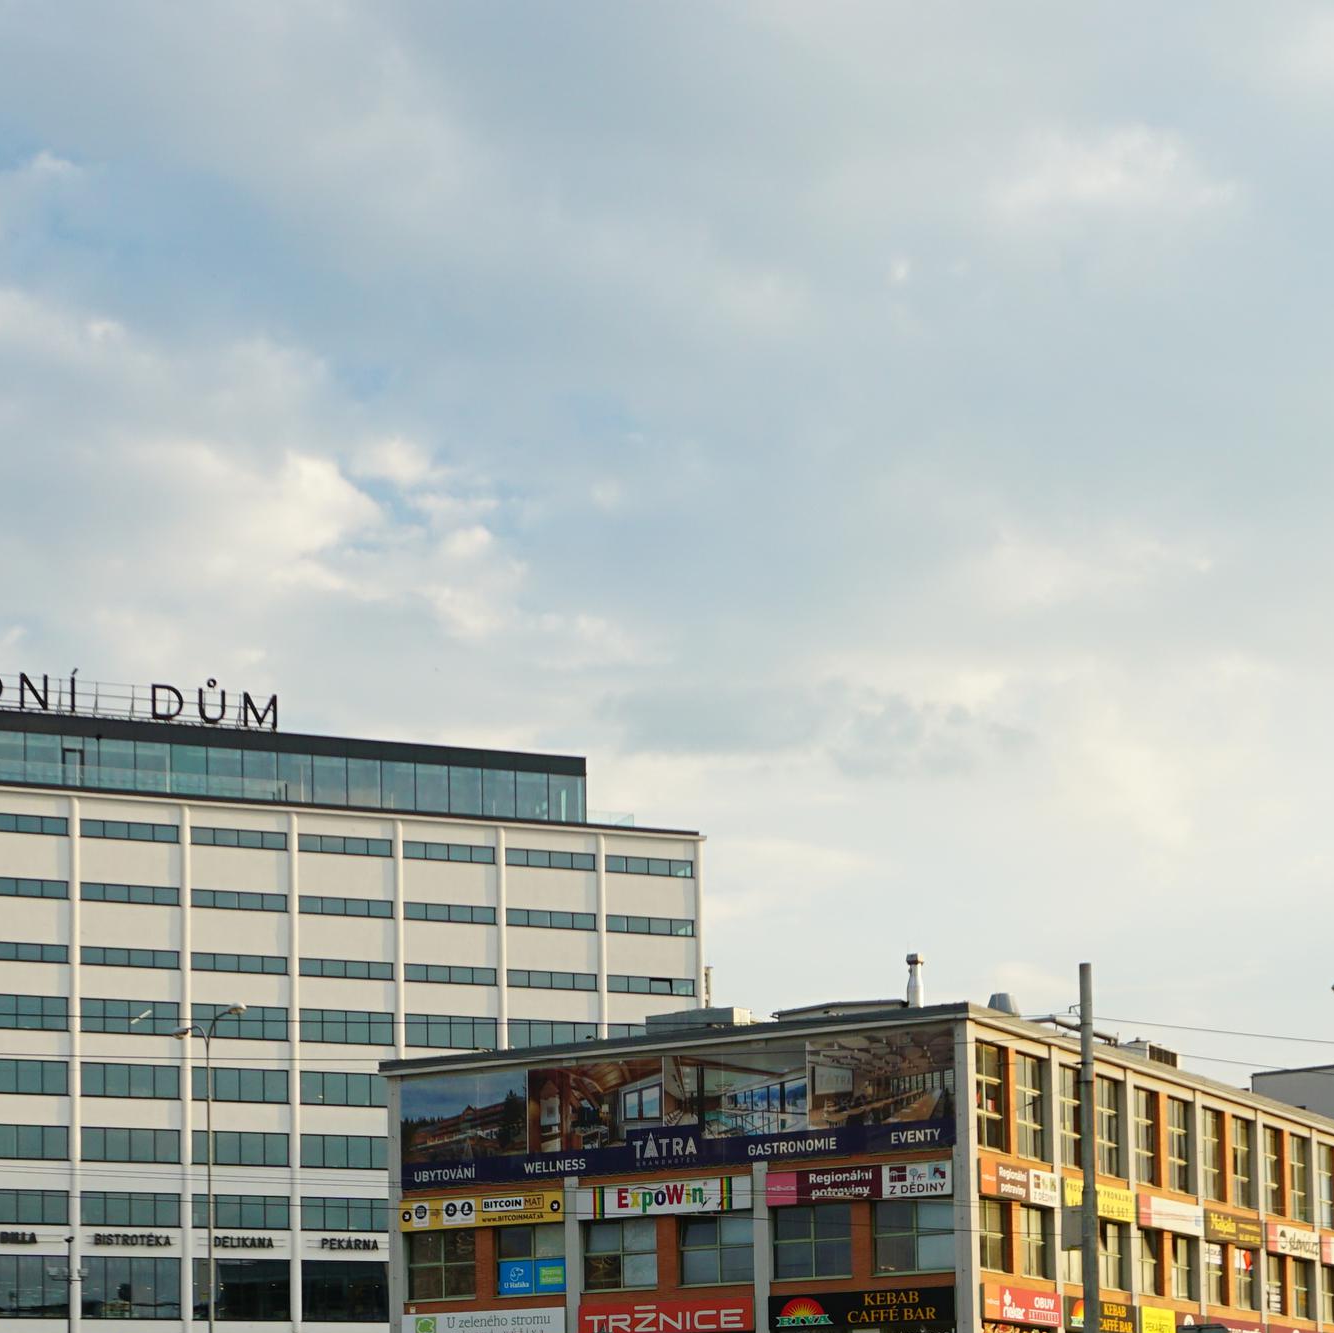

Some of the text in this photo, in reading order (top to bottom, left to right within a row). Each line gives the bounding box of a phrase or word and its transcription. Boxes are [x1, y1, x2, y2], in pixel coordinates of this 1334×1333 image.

[151, 678, 278, 731] DŮM
[891, 1128, 940, 1145] EVENTY
[747, 1137, 837, 1156] GASTRONOMIE
[414, 1164, 475, 1183] UBYTOVÁNÍ
[524, 1158, 586, 1174] WELLNESS
[808, 1169, 873, 1185] Regionální
[810, 1185, 871, 1200] potraviny
[889, 1181, 946, 1195] Z DĚDINY
[483, 1197, 542, 1209] BITCOIN MAT
[94, 1233, 172, 1247] BISTROTÉKA
[214, 1236, 274, 1249] DELIKANA
[321, 1236, 379, 1250] PEKÁRNA
[864, 1290, 919, 1306] KEBAB
[847, 1307, 936, 1324] CAFFÉ BAR
[1103, 1303, 1127, 1318] KEBAB
[447, 1314, 551, 1329] U zeleného stromu
[585, 1305, 744, 1333] TRŽNICE
[777, 1315, 830, 1327] RIVA
[1119, 1319, 1133, 1333] BAR
